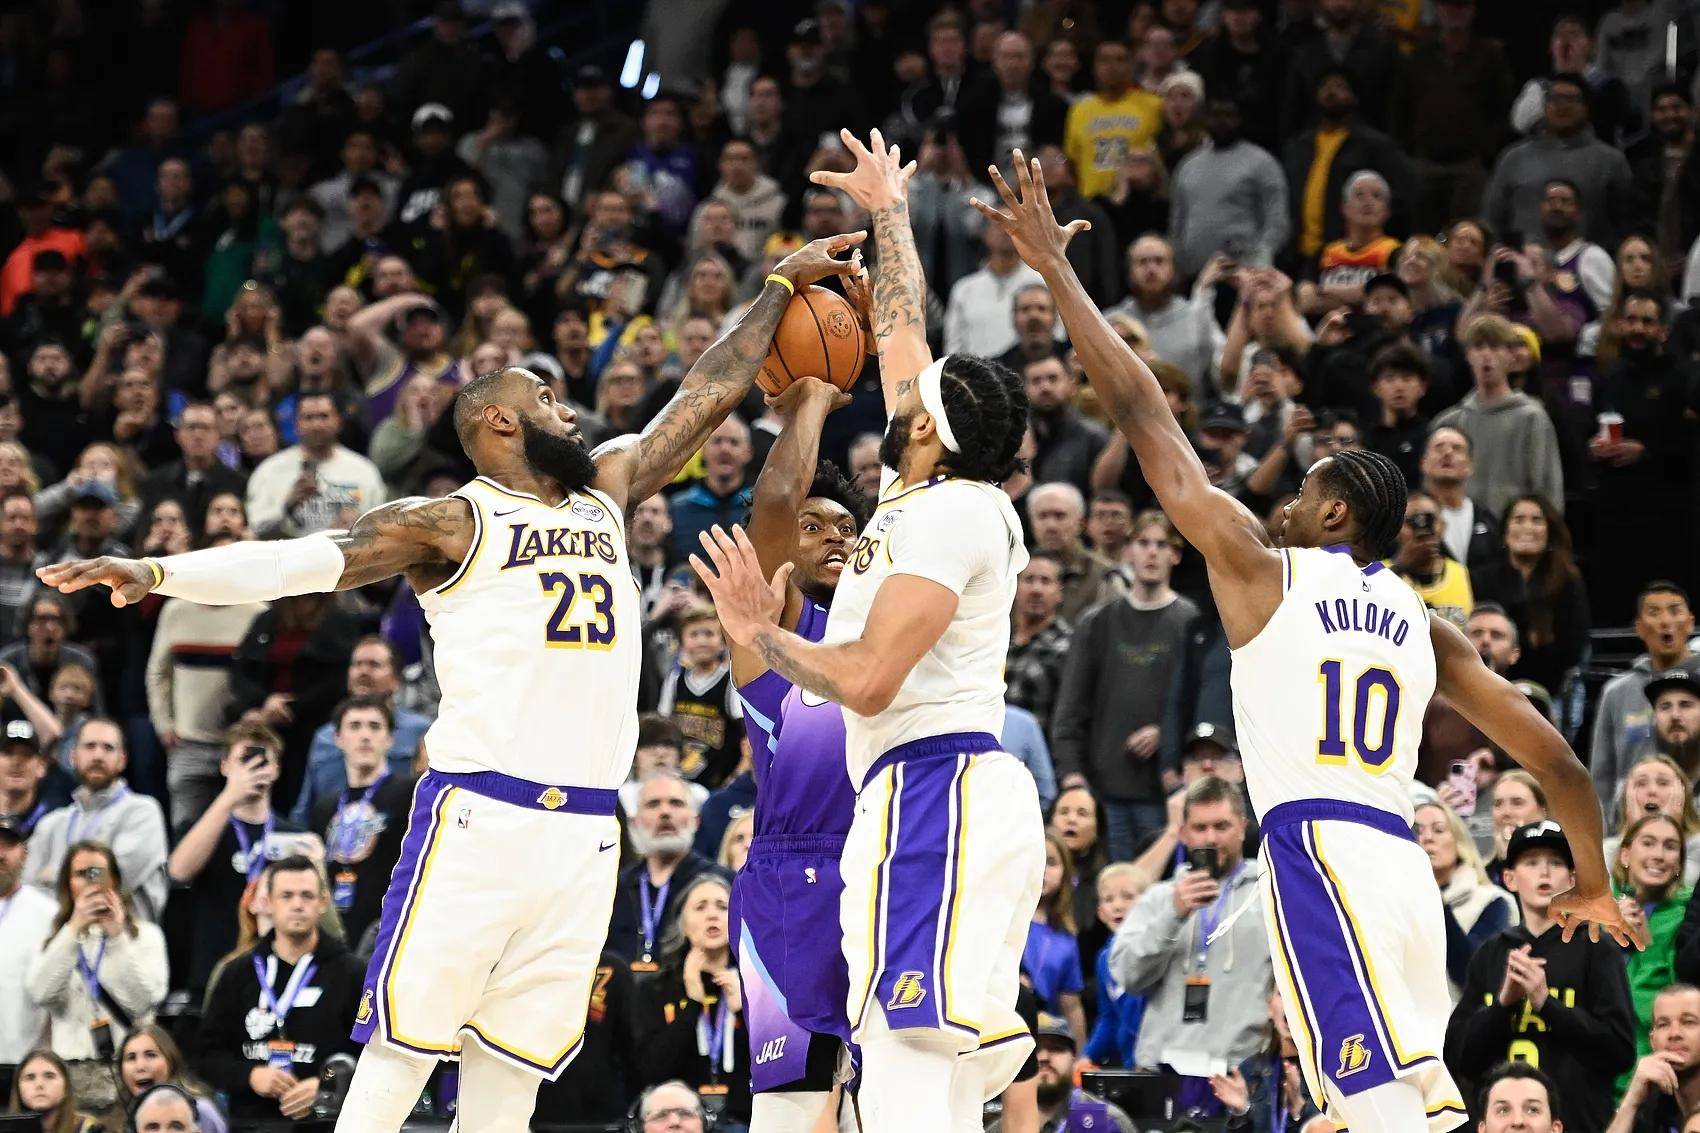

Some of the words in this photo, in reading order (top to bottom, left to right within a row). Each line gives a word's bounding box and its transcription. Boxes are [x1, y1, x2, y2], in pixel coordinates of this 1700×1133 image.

[501, 523, 617, 570] LAKERS
[538, 571, 617, 651] 23
[1315, 598, 1409, 647] KOLOKO
[1316, 658, 1402, 773] 10
[755, 1035, 787, 1065] JAZZ
